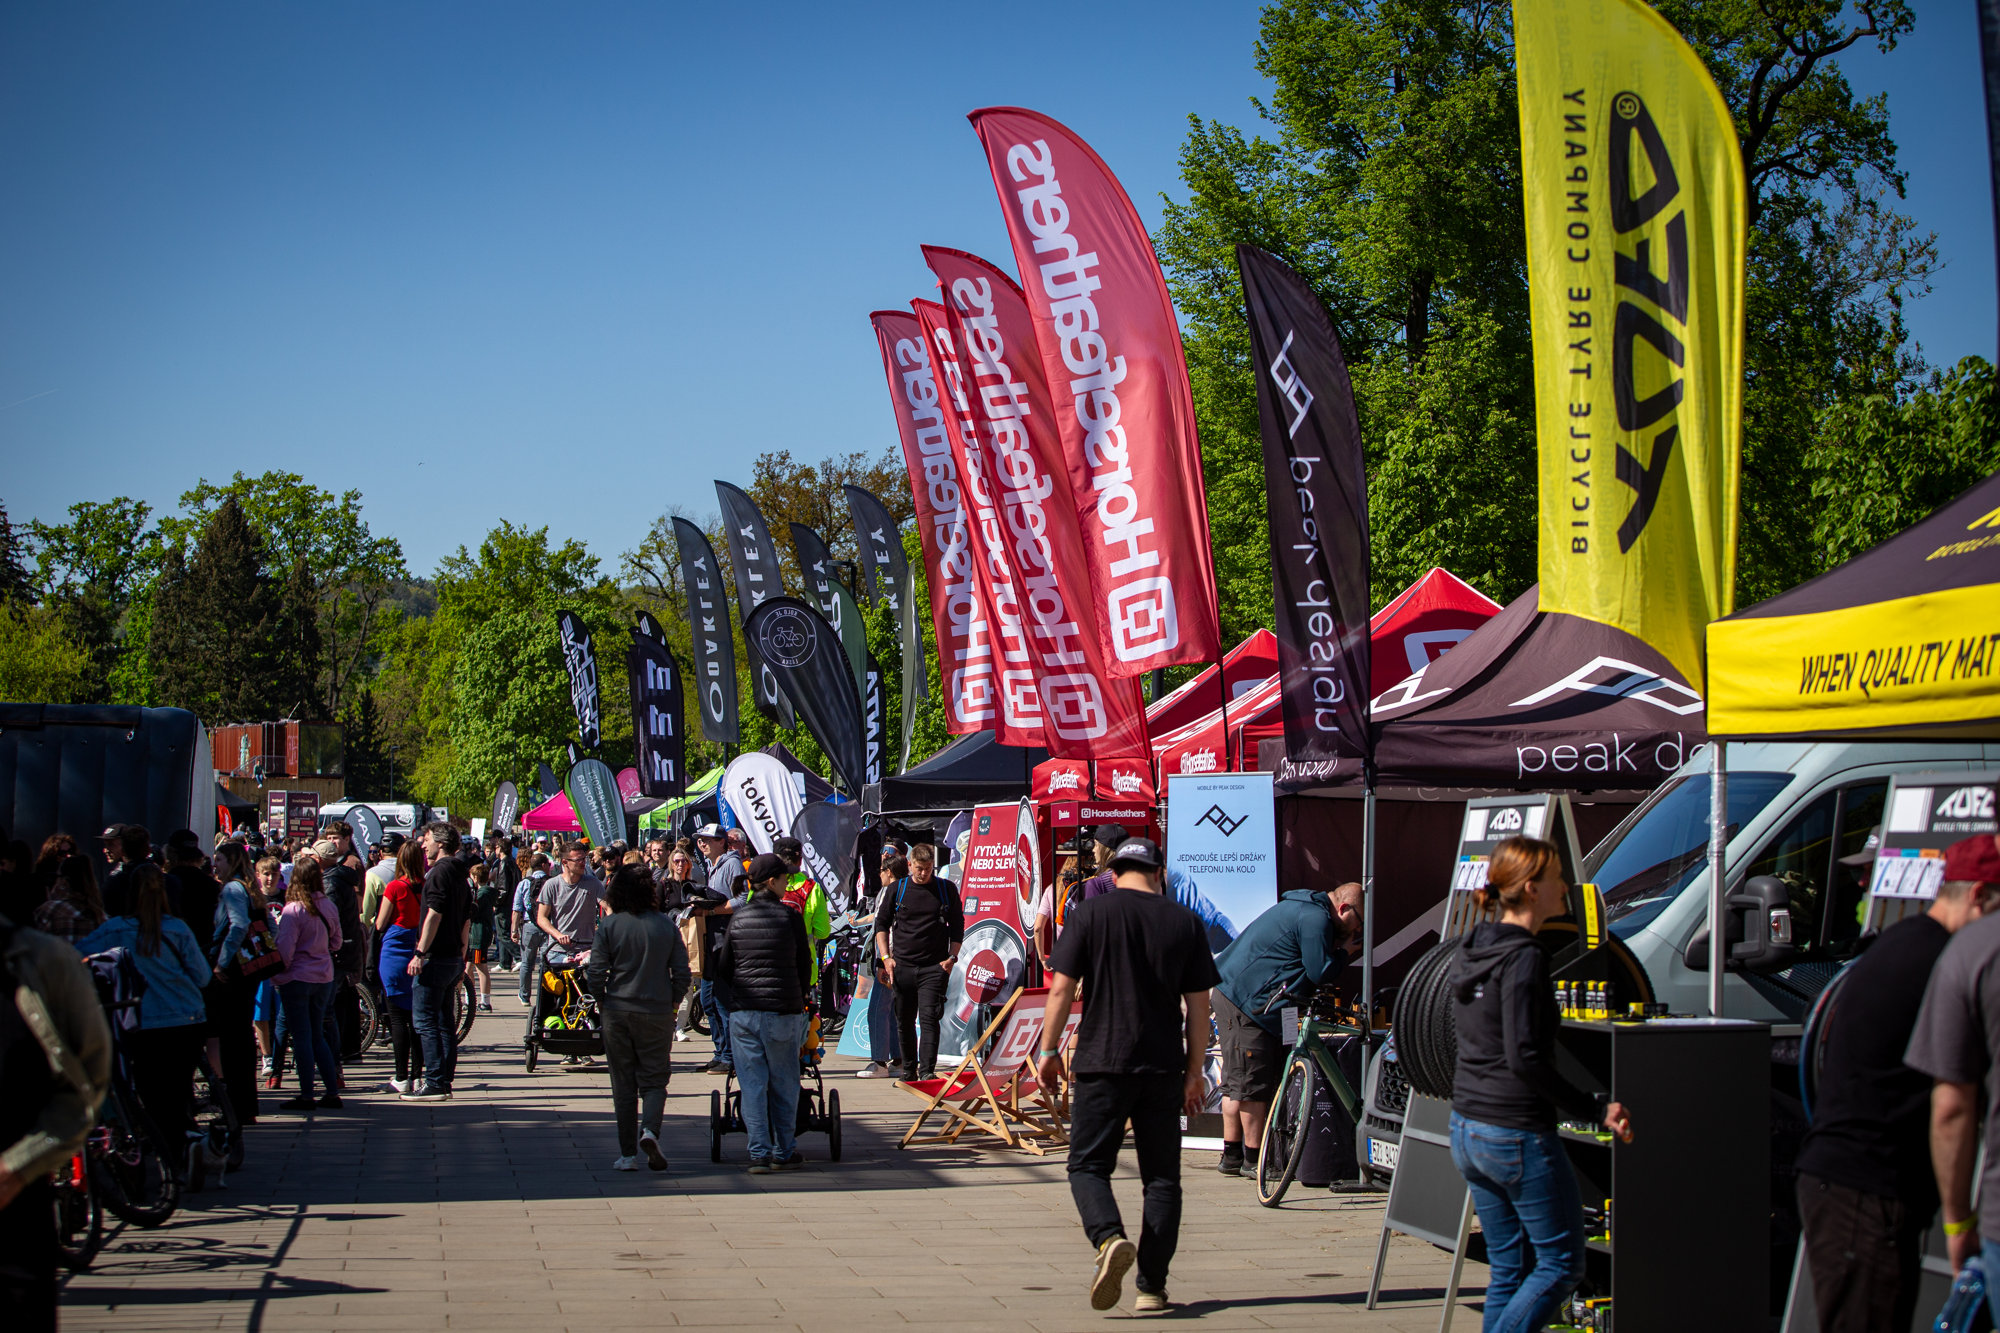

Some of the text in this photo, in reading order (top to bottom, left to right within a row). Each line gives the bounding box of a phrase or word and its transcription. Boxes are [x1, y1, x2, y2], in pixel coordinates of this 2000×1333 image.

[1799, 652, 1857, 695] WHEN
[1859, 641, 1952, 699] QUALITY
[1516, 735, 1638, 779] peak
[1091, 808, 1146, 818] Horsefeathers
[1489, 808, 1523, 831] TUFO
[974, 842, 1002, 857] VYTOČ
[1176, 851, 1267, 863] JEDNODUŠE LEPŠÍ DRŽÁKY
[971, 858, 994, 870] NEBO
[1188, 865, 1256, 874] TELEFONU NA KOLO
